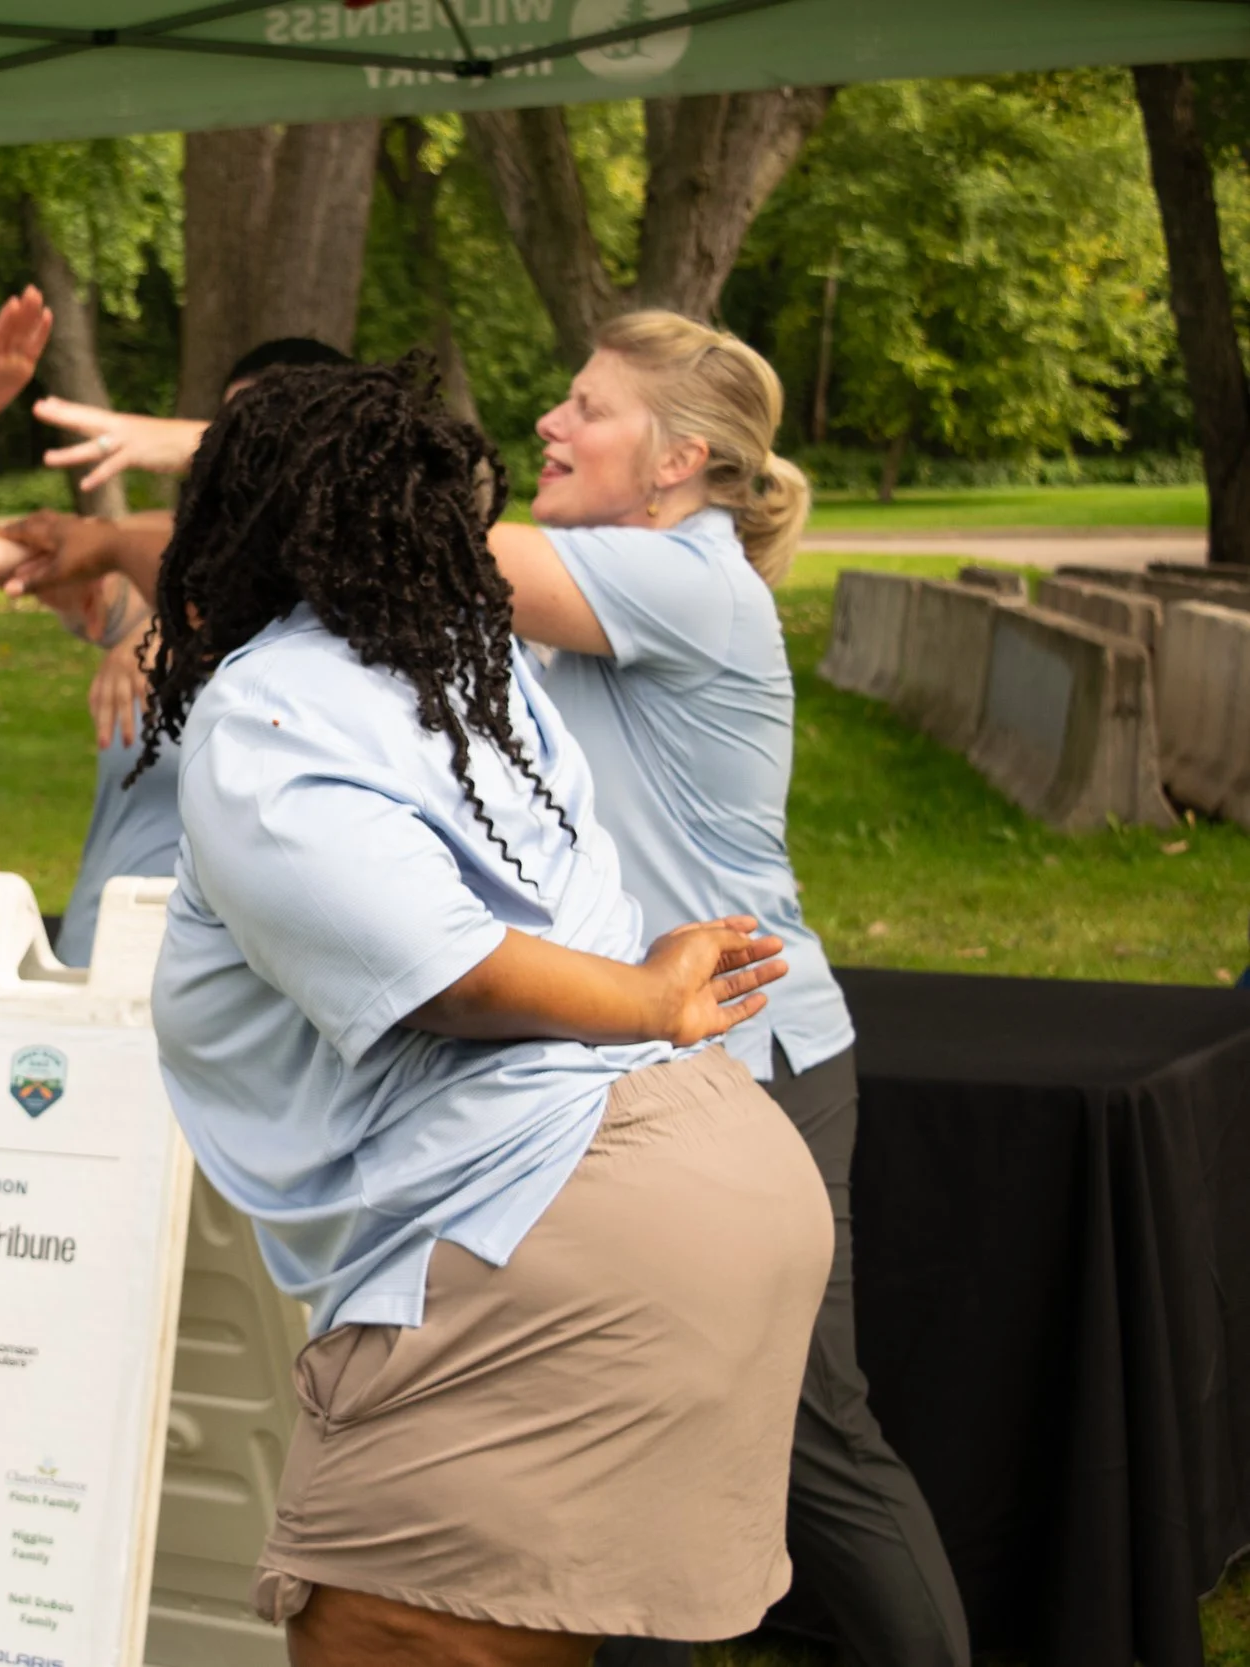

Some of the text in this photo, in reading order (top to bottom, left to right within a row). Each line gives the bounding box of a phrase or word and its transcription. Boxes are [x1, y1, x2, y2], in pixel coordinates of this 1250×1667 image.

[43, 1494, 82, 1513] Family
[12, 1547, 50, 1565] Family
[20, 1613, 59, 1631] Family
